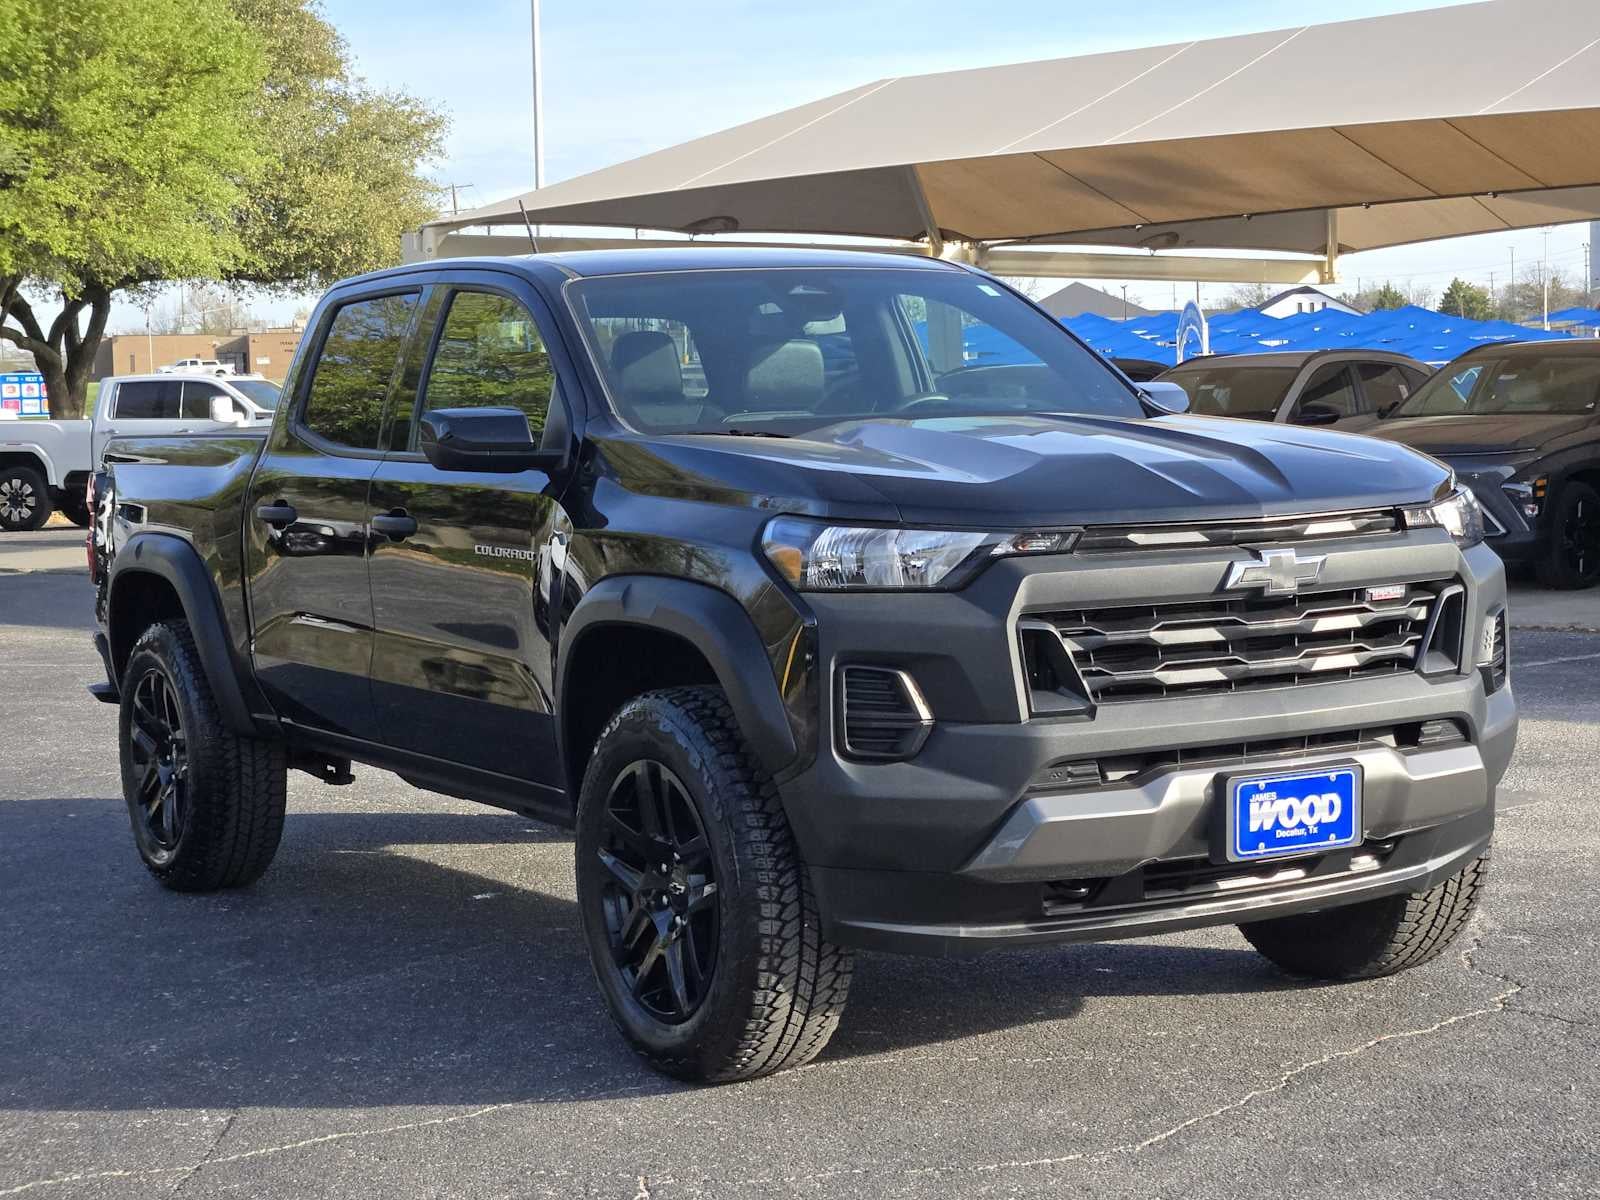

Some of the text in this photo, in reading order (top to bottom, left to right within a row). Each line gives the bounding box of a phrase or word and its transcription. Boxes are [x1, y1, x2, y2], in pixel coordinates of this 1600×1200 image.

[474, 544, 535, 561] COLORADO
[1250, 792, 1277, 802] JAMES
[1249, 793, 1342, 832] WOOD
